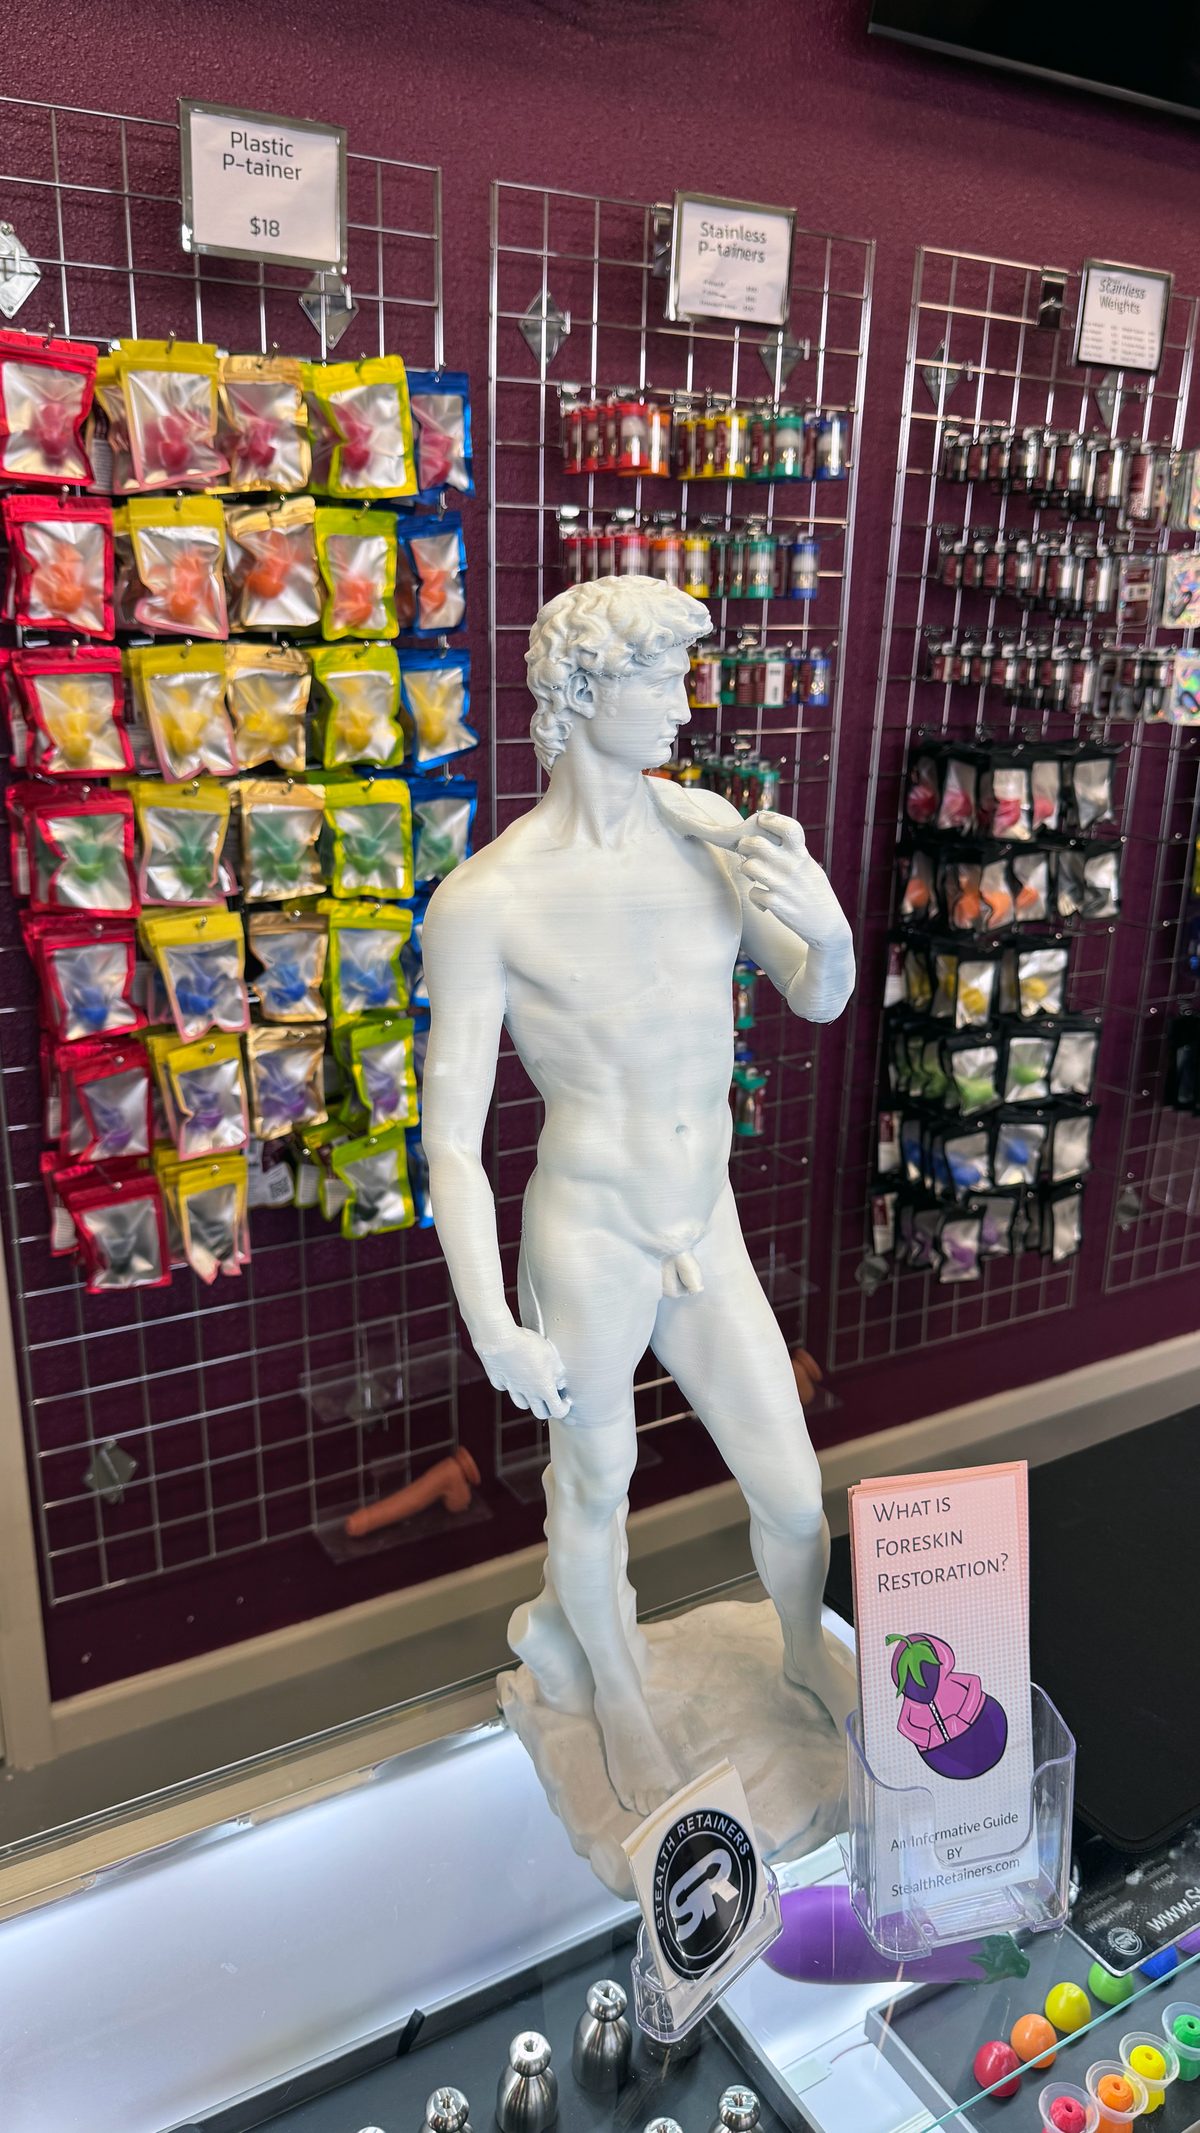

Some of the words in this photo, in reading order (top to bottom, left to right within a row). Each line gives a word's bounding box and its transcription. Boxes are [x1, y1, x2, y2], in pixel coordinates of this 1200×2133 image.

[231, 131, 294, 158] Plastic
[223, 153, 302, 181] P-tainer
[250, 215, 281, 238] $18
[700, 221, 767, 244] Stainless
[698, 240, 766, 263] P-tainers
[1099, 277, 1147, 300] Stainless
[1099, 295, 1141, 315] Weights
[890, 1838, 906, 1852] An
[911, 1821, 981, 1847] Informative
[983, 1812, 1019, 1830] Guide
[946, 1846, 963, 1861] BY
[656, 1838, 675, 1927] STEALTH
[678, 1814, 749, 1856] RETAINERS
[891, 1856, 1020, 1898] StealthRetainers.com
